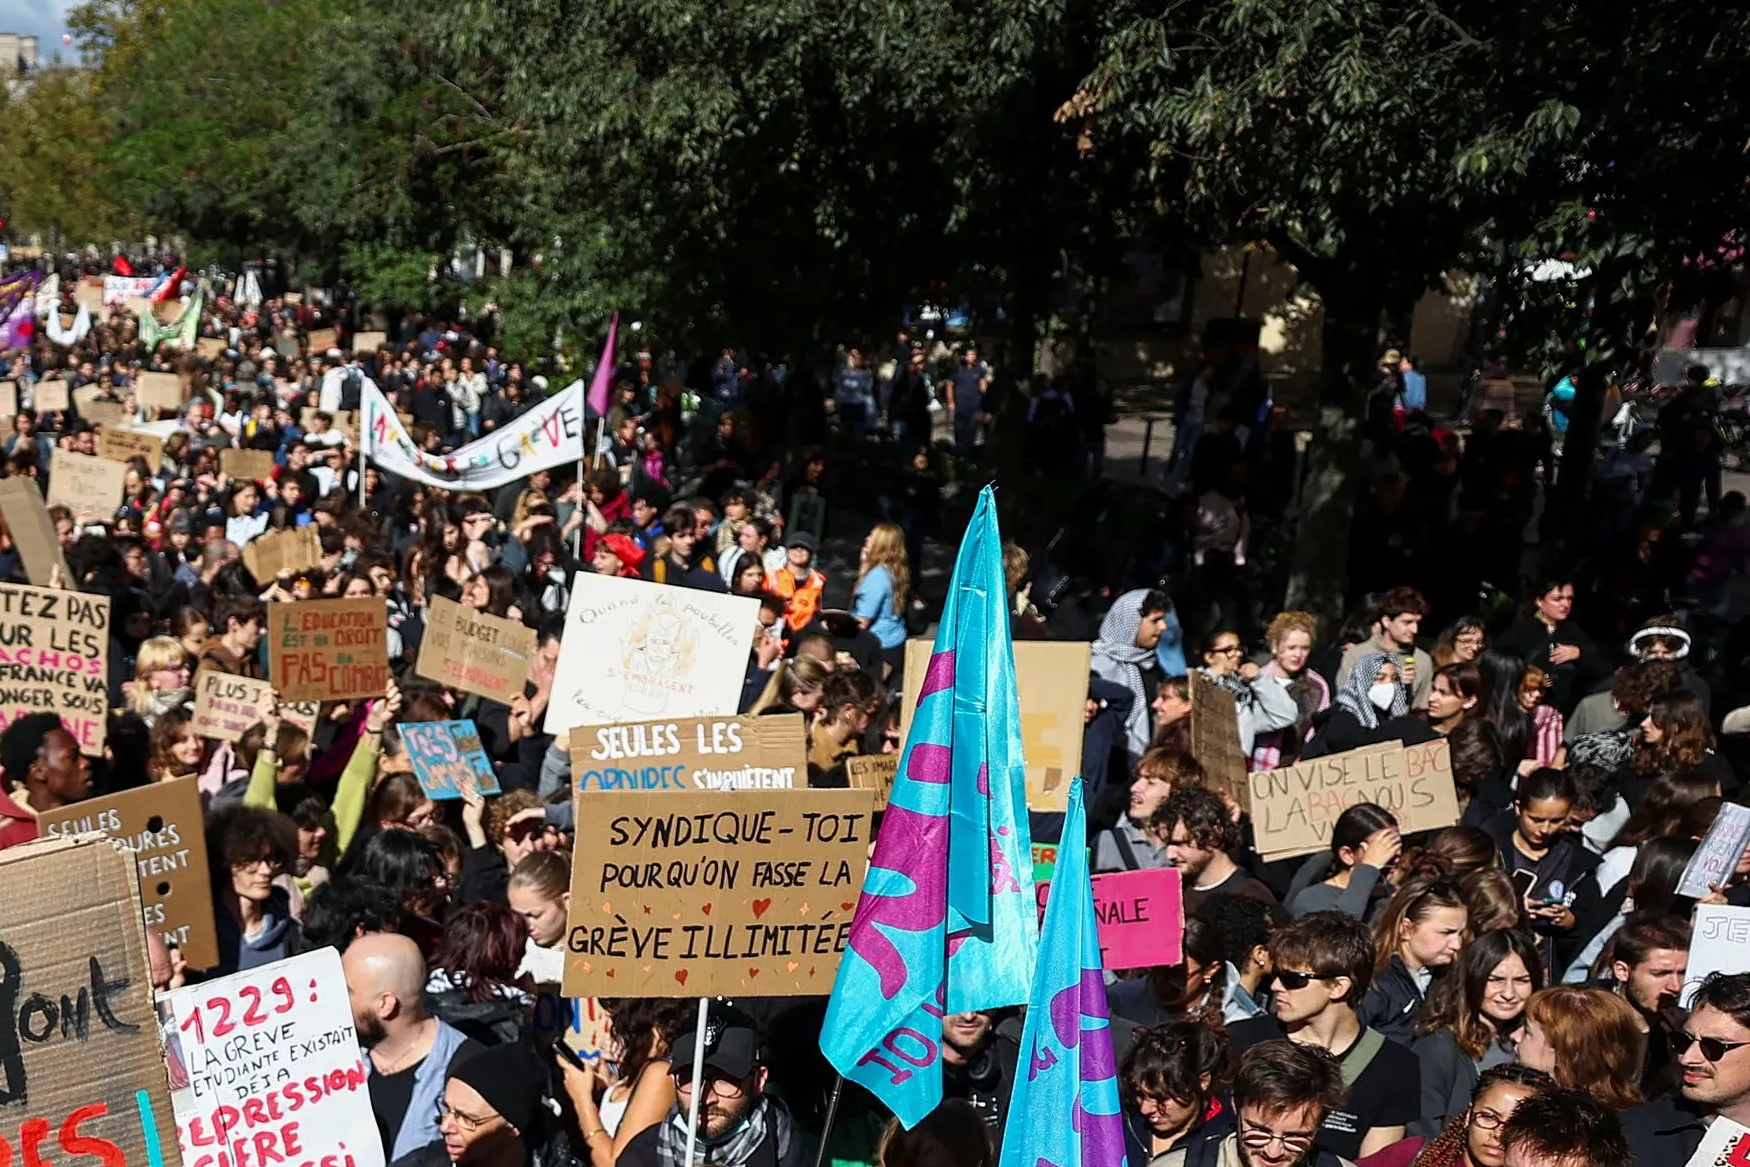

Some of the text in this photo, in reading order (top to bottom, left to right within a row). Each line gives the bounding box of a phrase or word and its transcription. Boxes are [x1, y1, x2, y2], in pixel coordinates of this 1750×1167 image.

[67, 594, 108, 630] PAS
[50, 625, 100, 659] LES
[334, 627, 382, 648] DROIT
[454, 615, 500, 646] BUDGET
[82, 676, 109, 694] VA
[281, 652, 327, 687] PAS
[62, 691, 103, 715] SOUS
[205, 675, 248, 700] PLUS
[591, 721, 744, 761] SEULES LES
[1253, 743, 1451, 800] ON VISE LE BAC
[1264, 796, 1308, 835] LA
[1357, 777, 1436, 810] NOUS
[752, 860, 812, 888] FASSE
[819, 860, 852, 887] LA
[1096, 898, 1150, 926] NALE
[568, 910, 852, 959] GRÈVE ILLIMITÉE
[1703, 915, 1749, 944] JE
[180, 975, 295, 1044] 1229
[191, 1049, 222, 1076] LA
